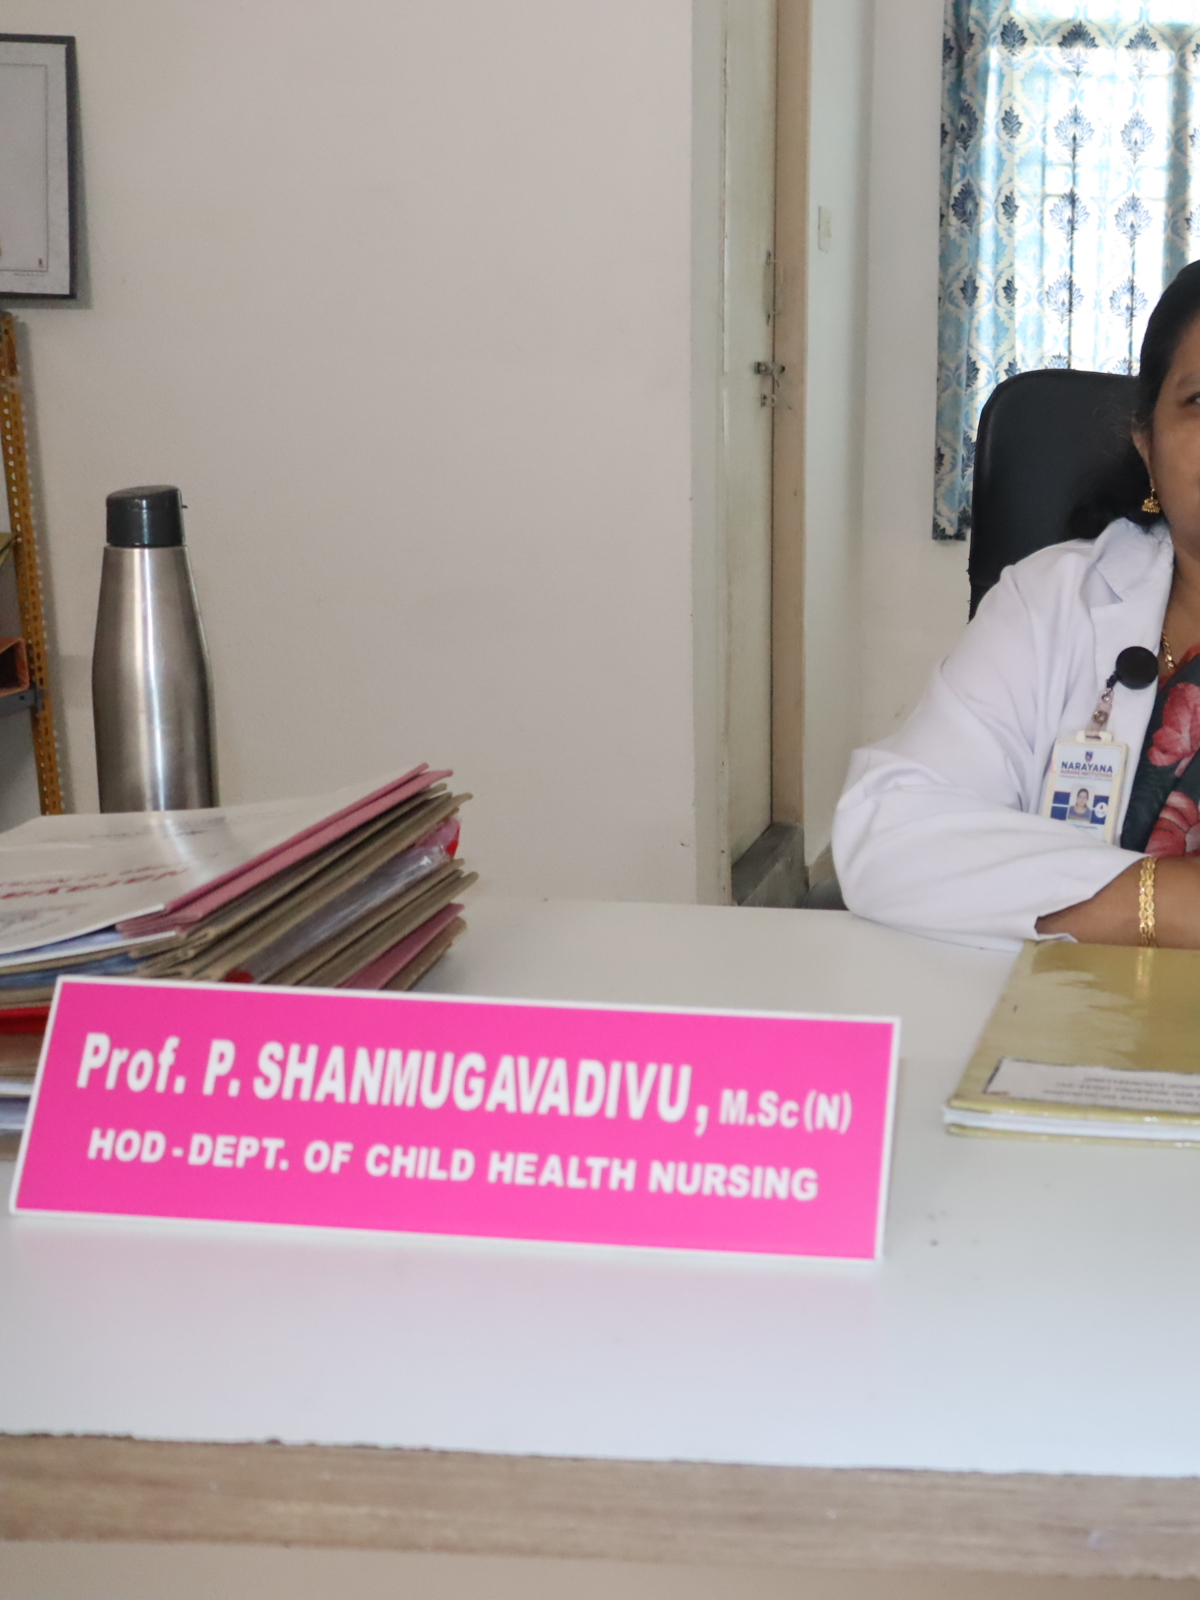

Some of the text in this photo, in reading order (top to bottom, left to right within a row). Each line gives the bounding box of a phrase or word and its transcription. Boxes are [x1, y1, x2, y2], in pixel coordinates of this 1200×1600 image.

[1061, 761, 1113, 773] NARAYANA
[77, 1033, 186, 1095] Prof.
[203, 1039, 240, 1097] P.
[253, 1041, 709, 1136] SHANMUGAVADIVU,
[304, 1140, 354, 1174] OF
[365, 1144, 475, 1181] CHILD
[487, 1151, 637, 1191] HEALTH
[648, 1160, 819, 1202] NURSING
